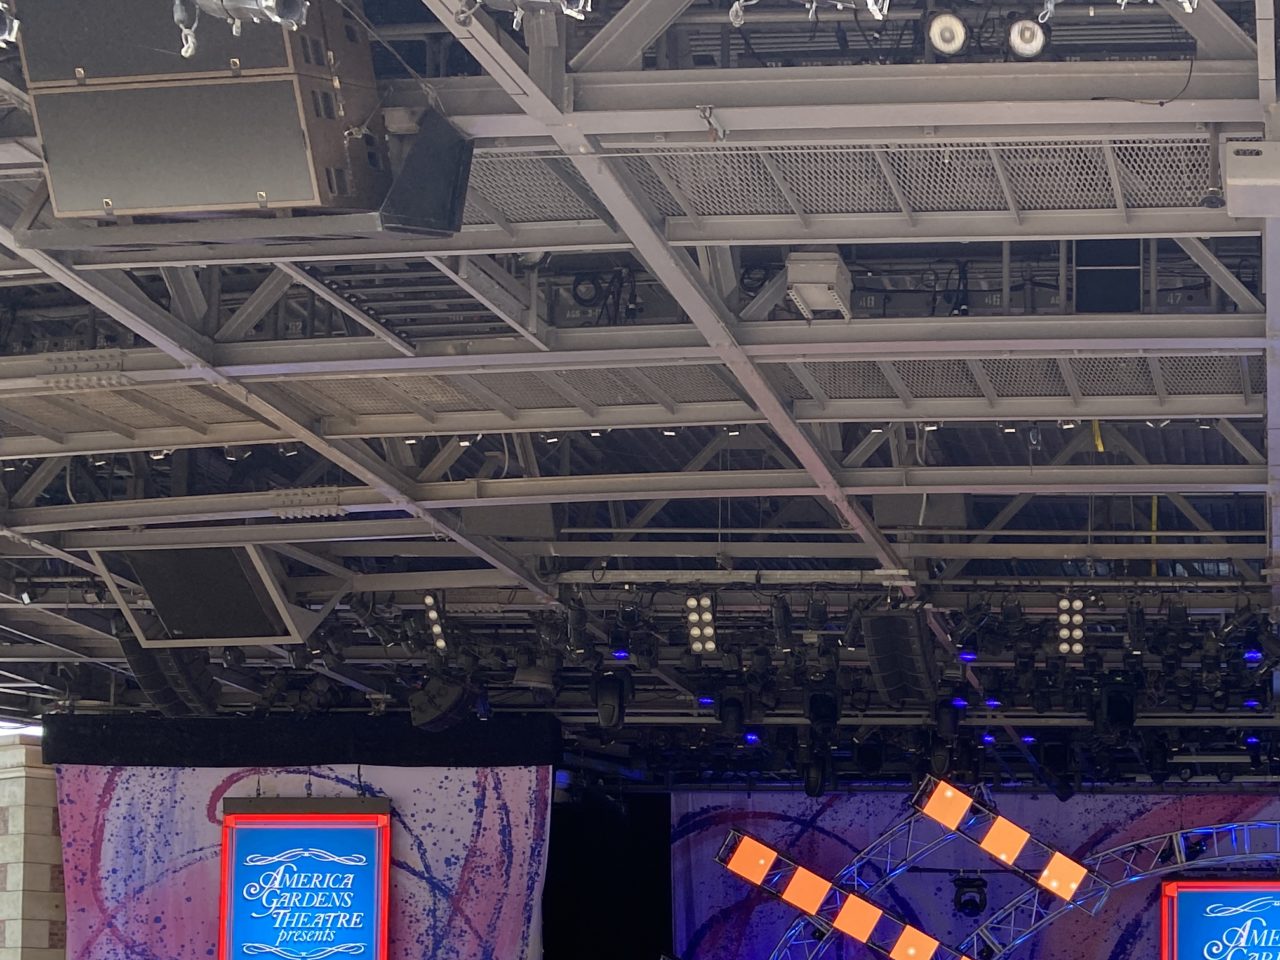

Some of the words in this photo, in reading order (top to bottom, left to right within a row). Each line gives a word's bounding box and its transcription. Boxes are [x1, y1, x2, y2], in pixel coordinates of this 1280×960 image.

[243, 864, 355, 899] AMERICA
[251, 889, 354, 918] GARDENS
[271, 909, 364, 928] THEATRE
[276, 927, 336, 946] presents
